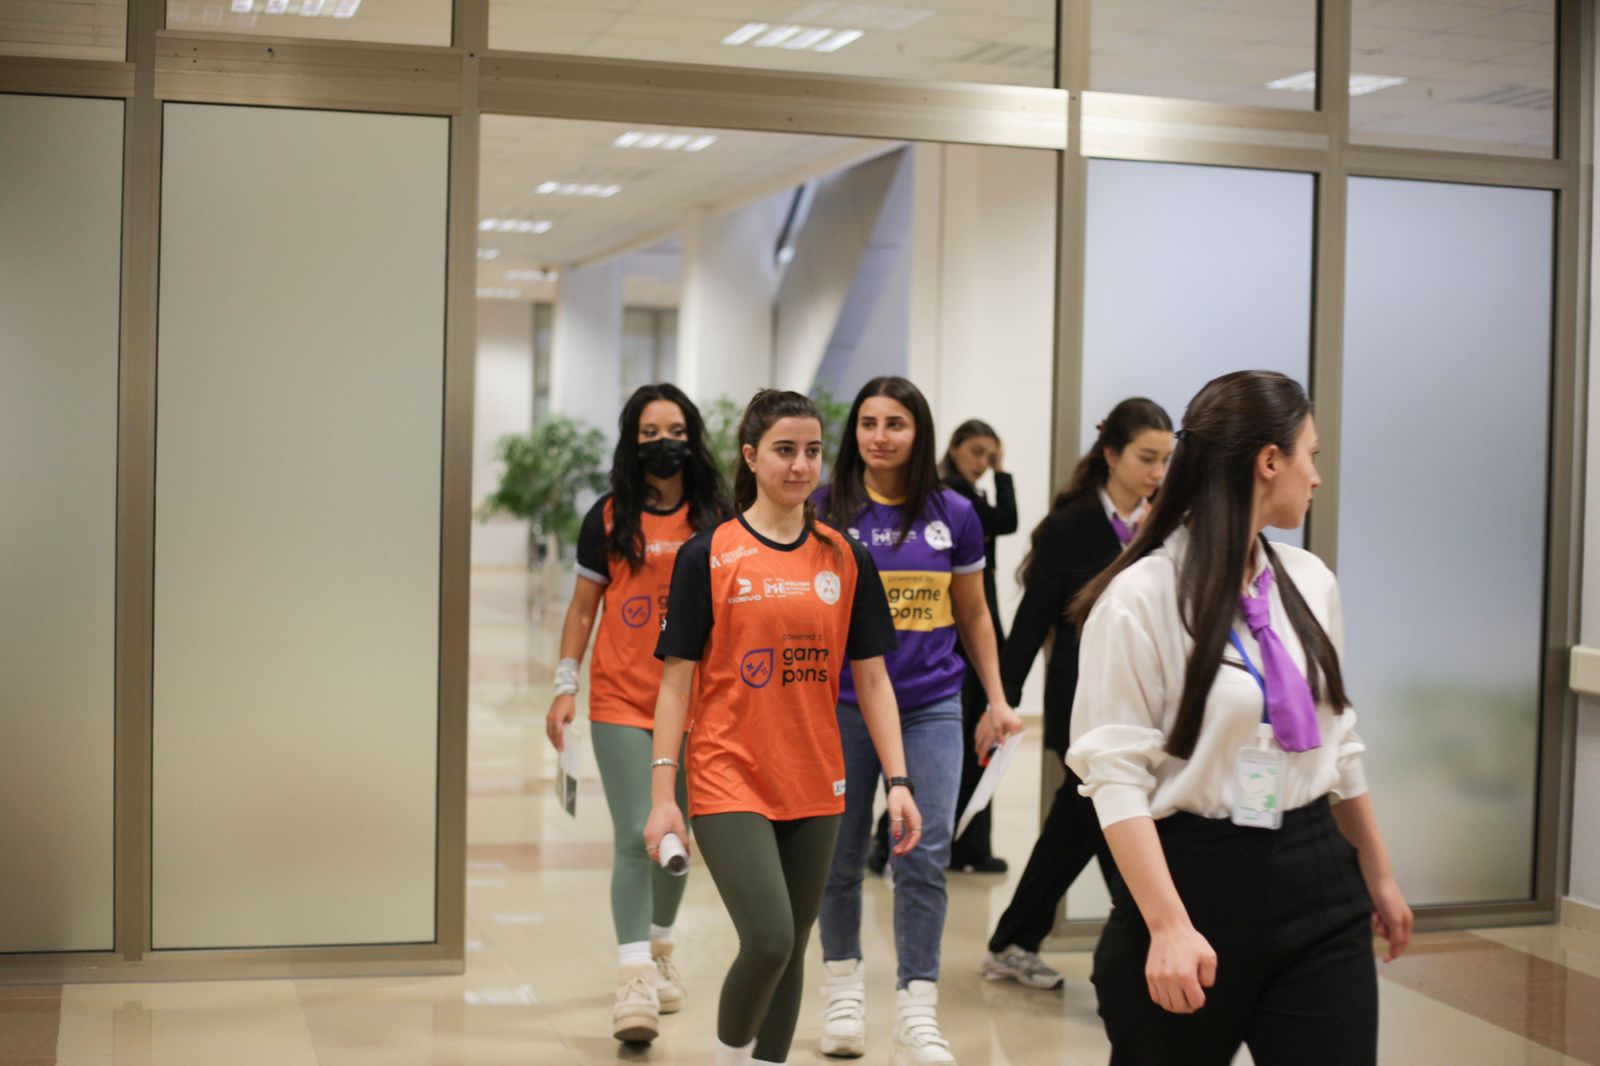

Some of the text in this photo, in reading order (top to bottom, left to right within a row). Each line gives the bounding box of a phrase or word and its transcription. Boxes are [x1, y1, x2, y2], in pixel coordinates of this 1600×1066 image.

[888, 588, 941, 603] game
[782, 647, 829, 666] gam
[782, 669, 828, 688] pons
